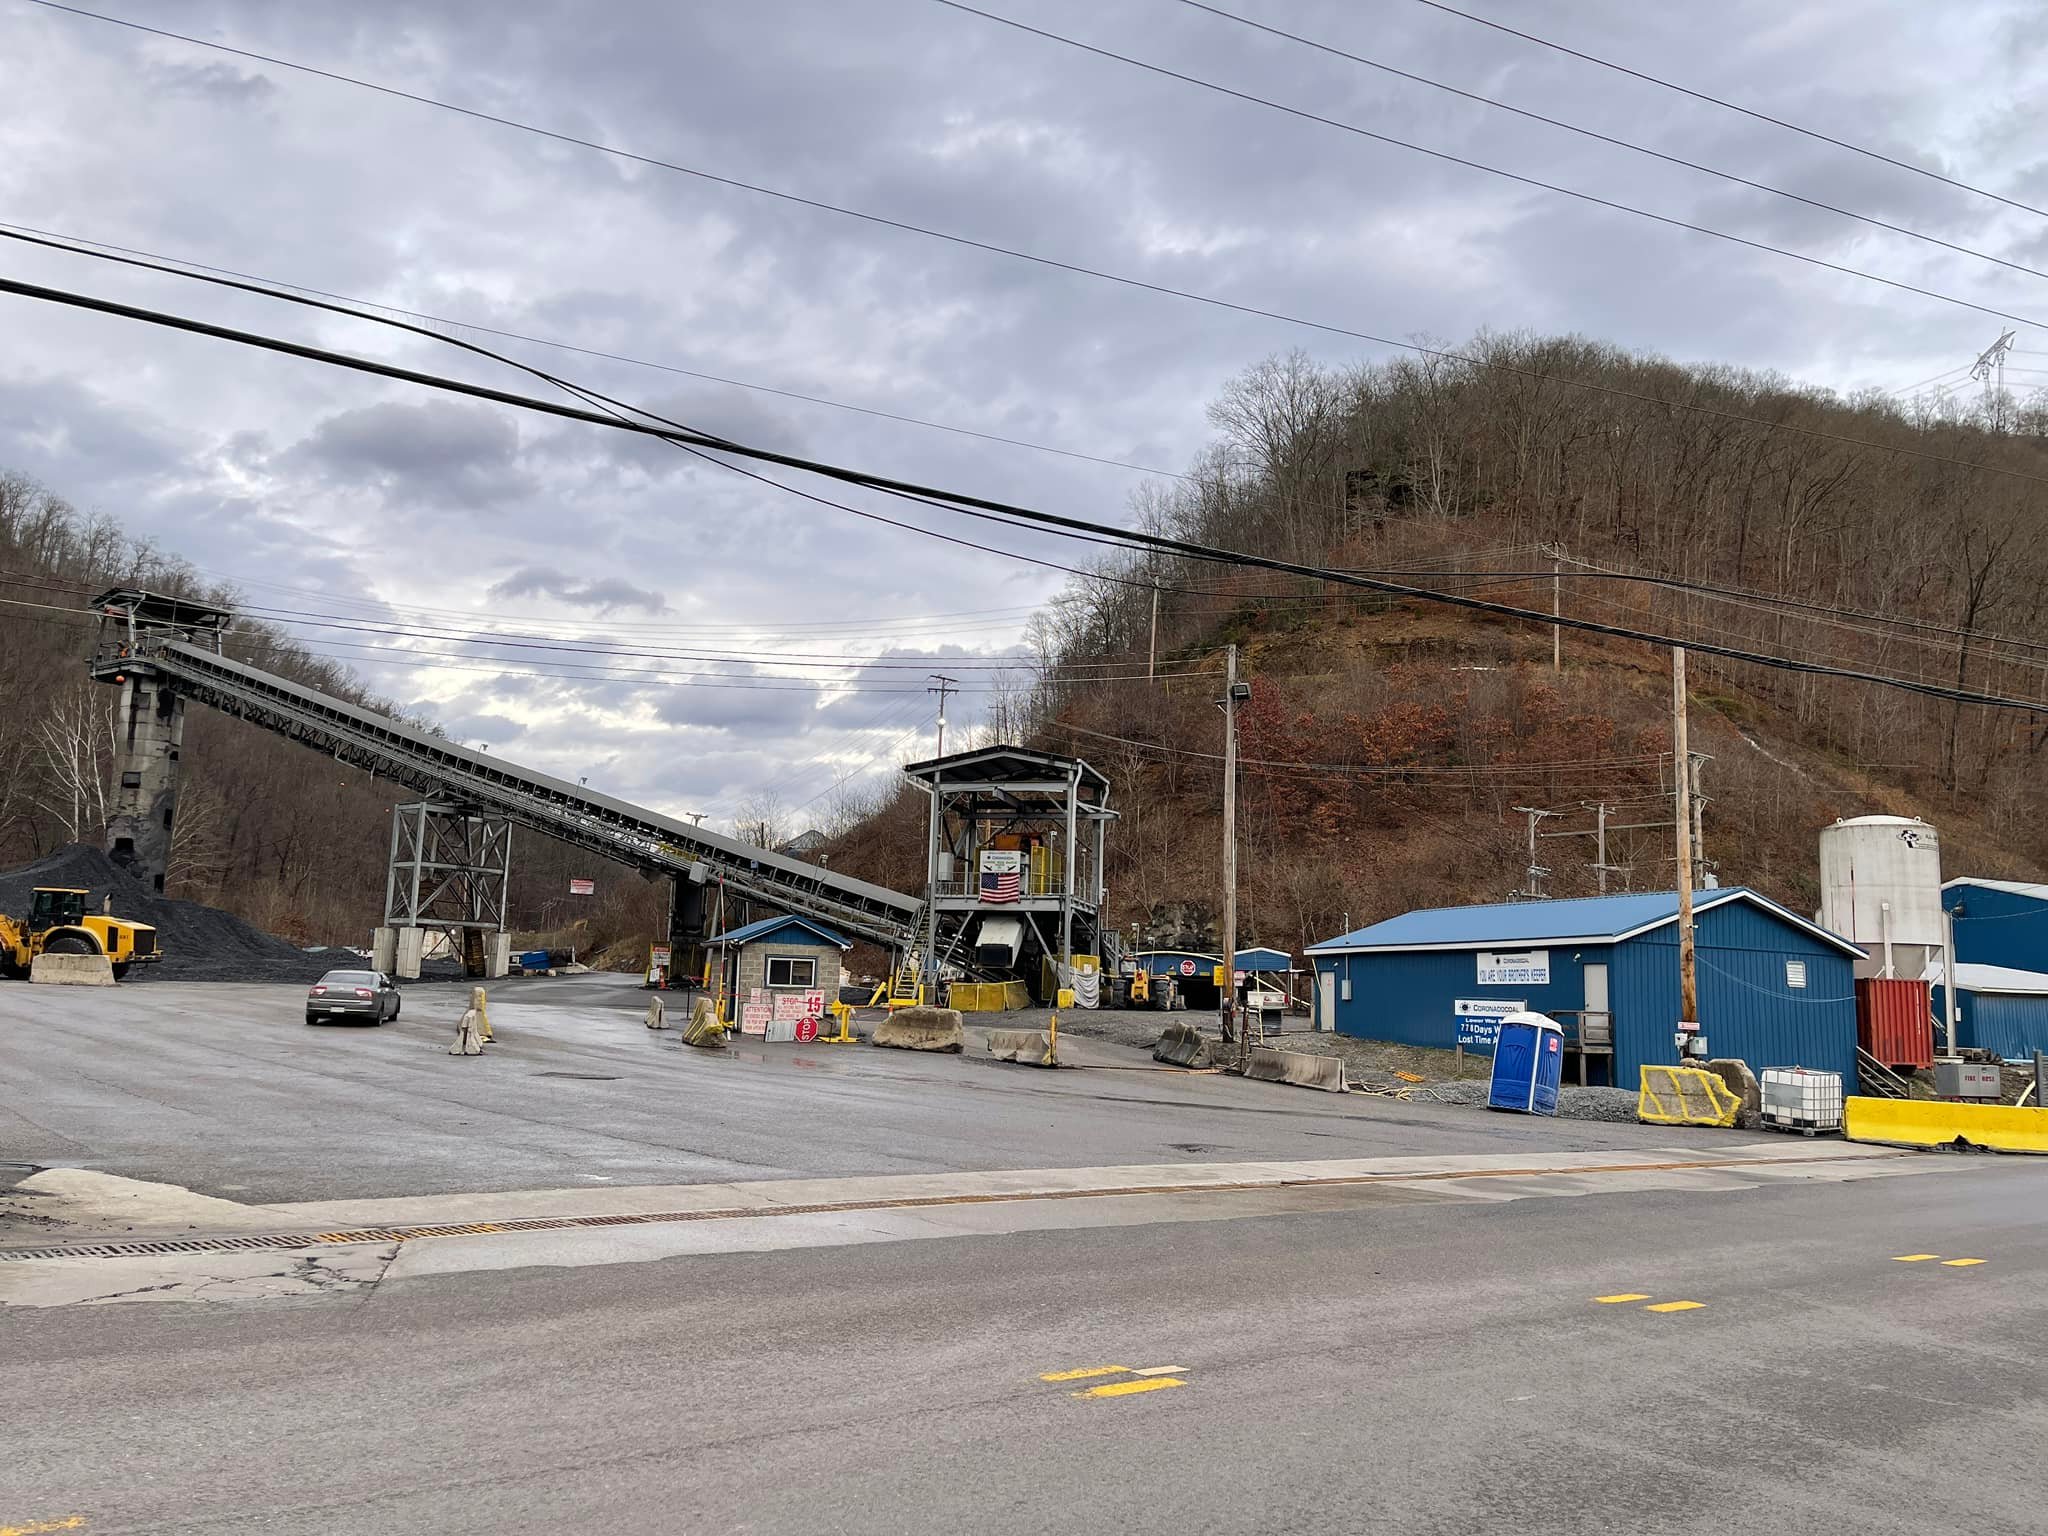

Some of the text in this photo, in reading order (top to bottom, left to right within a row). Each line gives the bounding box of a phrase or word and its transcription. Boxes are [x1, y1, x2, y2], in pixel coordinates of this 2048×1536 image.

[782, 997, 799, 1006] STOP
[807, 997, 821, 1013] 15
[802, 1018, 811, 1040] STOP
[1474, 1024, 1493, 1036] Days
[1458, 1035, 1474, 1044] Lost
[1474, 1036, 1492, 1045] Time
